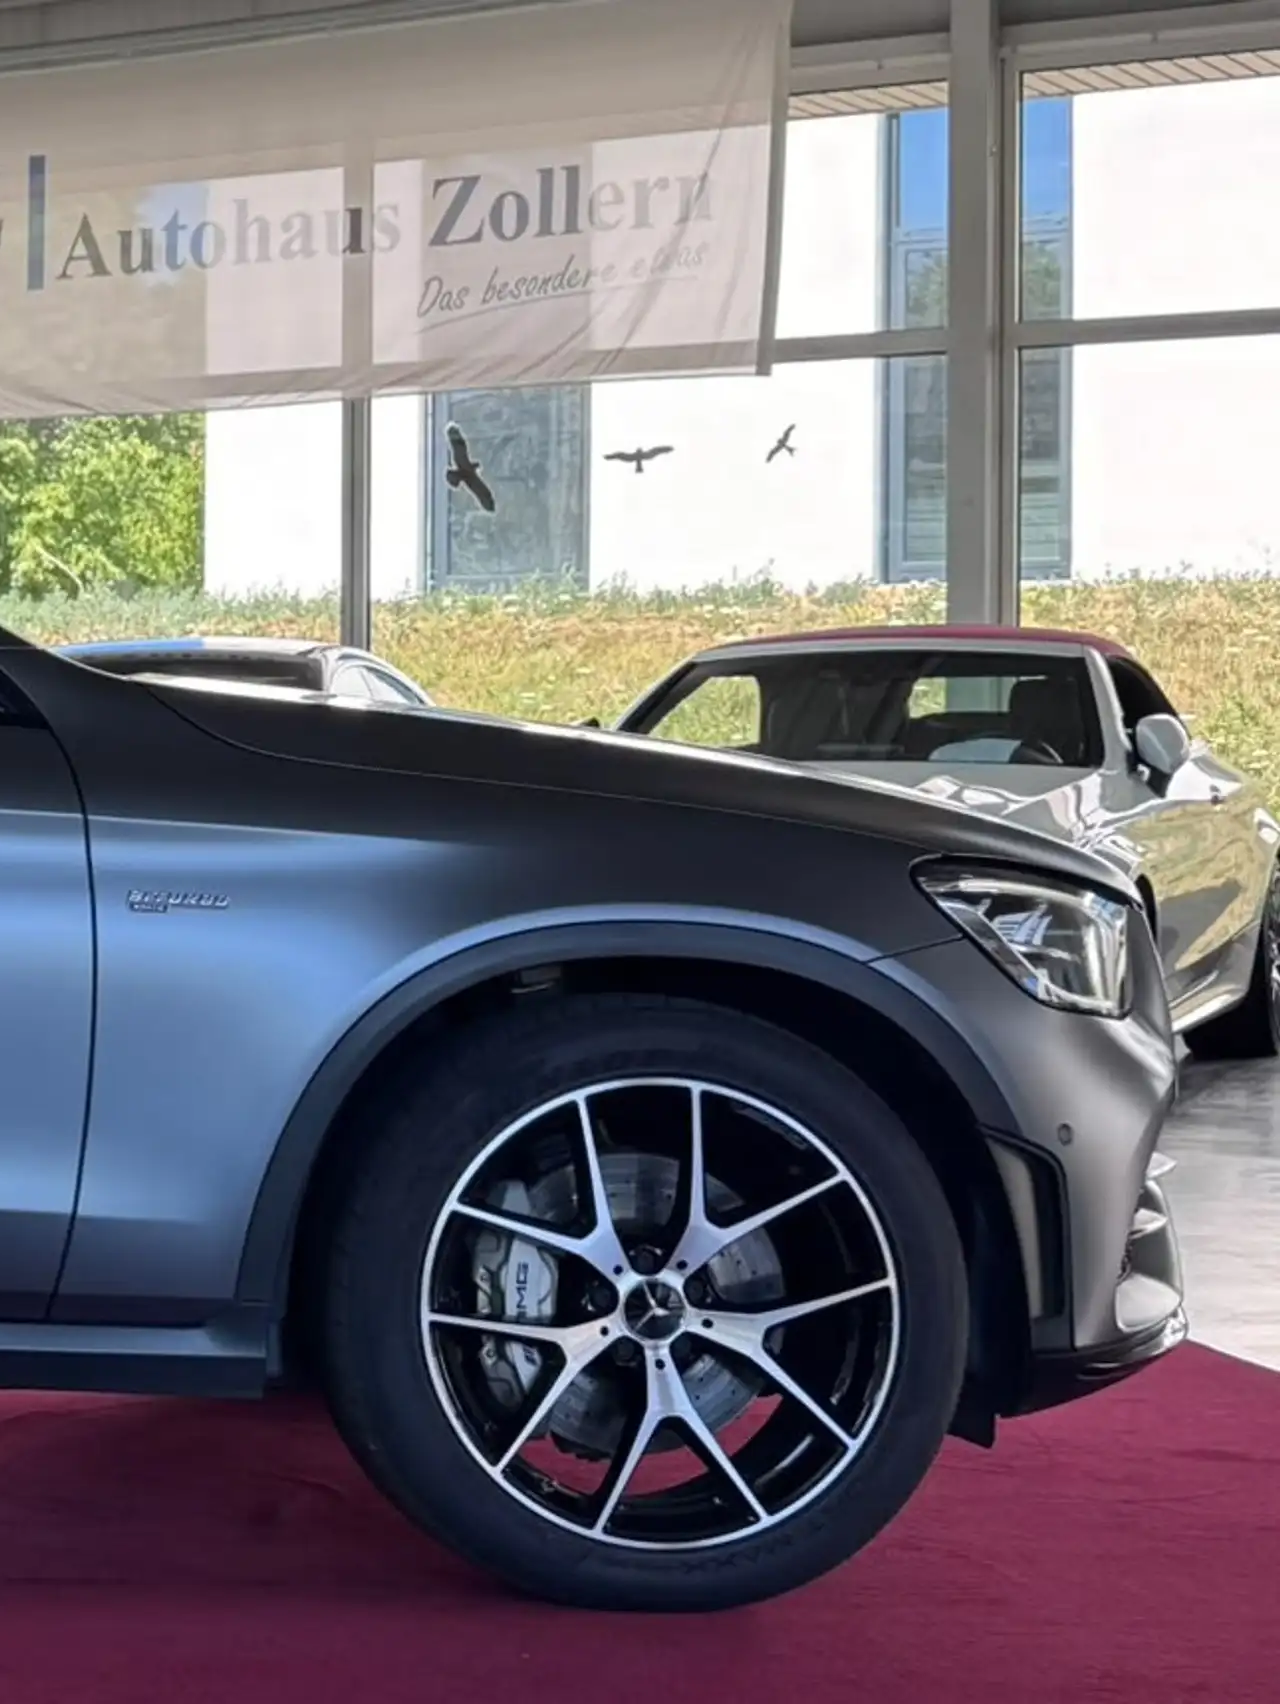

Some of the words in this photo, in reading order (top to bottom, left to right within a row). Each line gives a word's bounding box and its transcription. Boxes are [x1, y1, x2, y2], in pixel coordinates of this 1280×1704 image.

[55, 198, 402, 280] Autohaus
[427, 164, 716, 248] Zollern
[416, 275, 473, 319] Das
[480, 254, 618, 307] besondere
